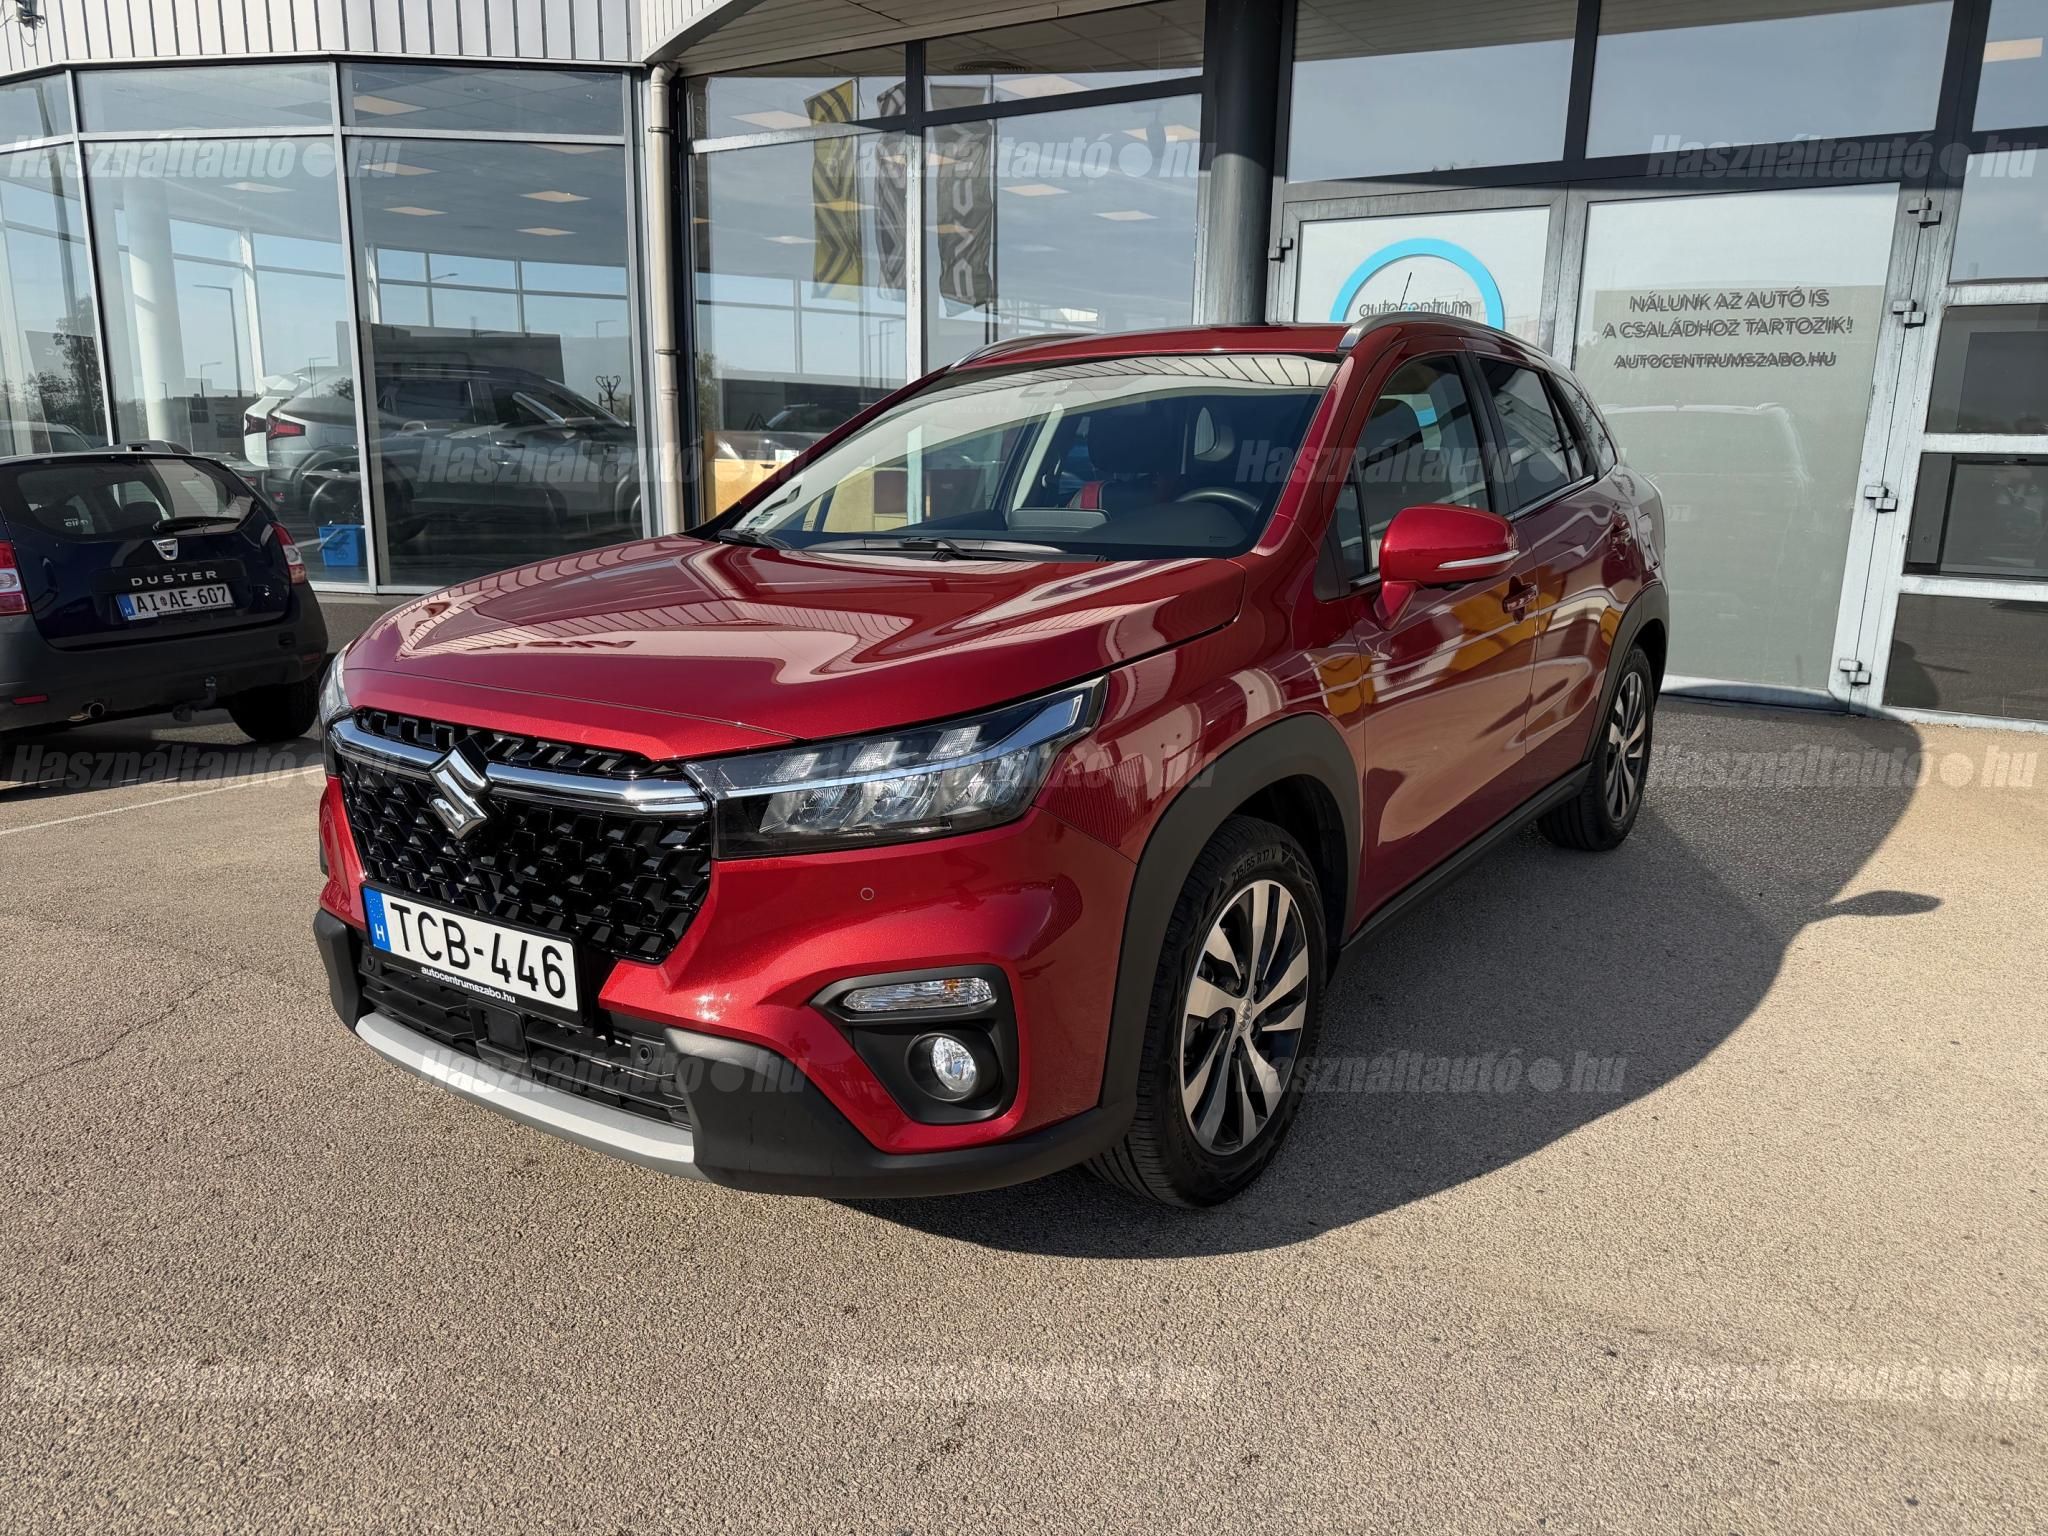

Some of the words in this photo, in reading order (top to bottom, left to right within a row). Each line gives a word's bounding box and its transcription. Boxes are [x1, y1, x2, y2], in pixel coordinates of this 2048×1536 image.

[1629, 290, 1711, 312] NÁLUNK
[1714, 293, 1743, 310] AZ
[1744, 286, 1806, 310] AUTÓ
[1808, 288, 1830, 307] IS
[1602, 322, 1617, 338] A
[1619, 316, 1741, 338] CSALÁDHOZ
[1743, 315, 1854, 336] TARTOZIK!
[1613, 351, 1838, 370] AUTOCENTRUMSZABO.HU
[130, 570, 219, 587] DUSTER
[169, 586, 227, 608] AE-607
[375, 923, 386, 943] H
[390, 902, 567, 999] TCB-446
[420, 965, 517, 1005] autocentrumszabo.hu
